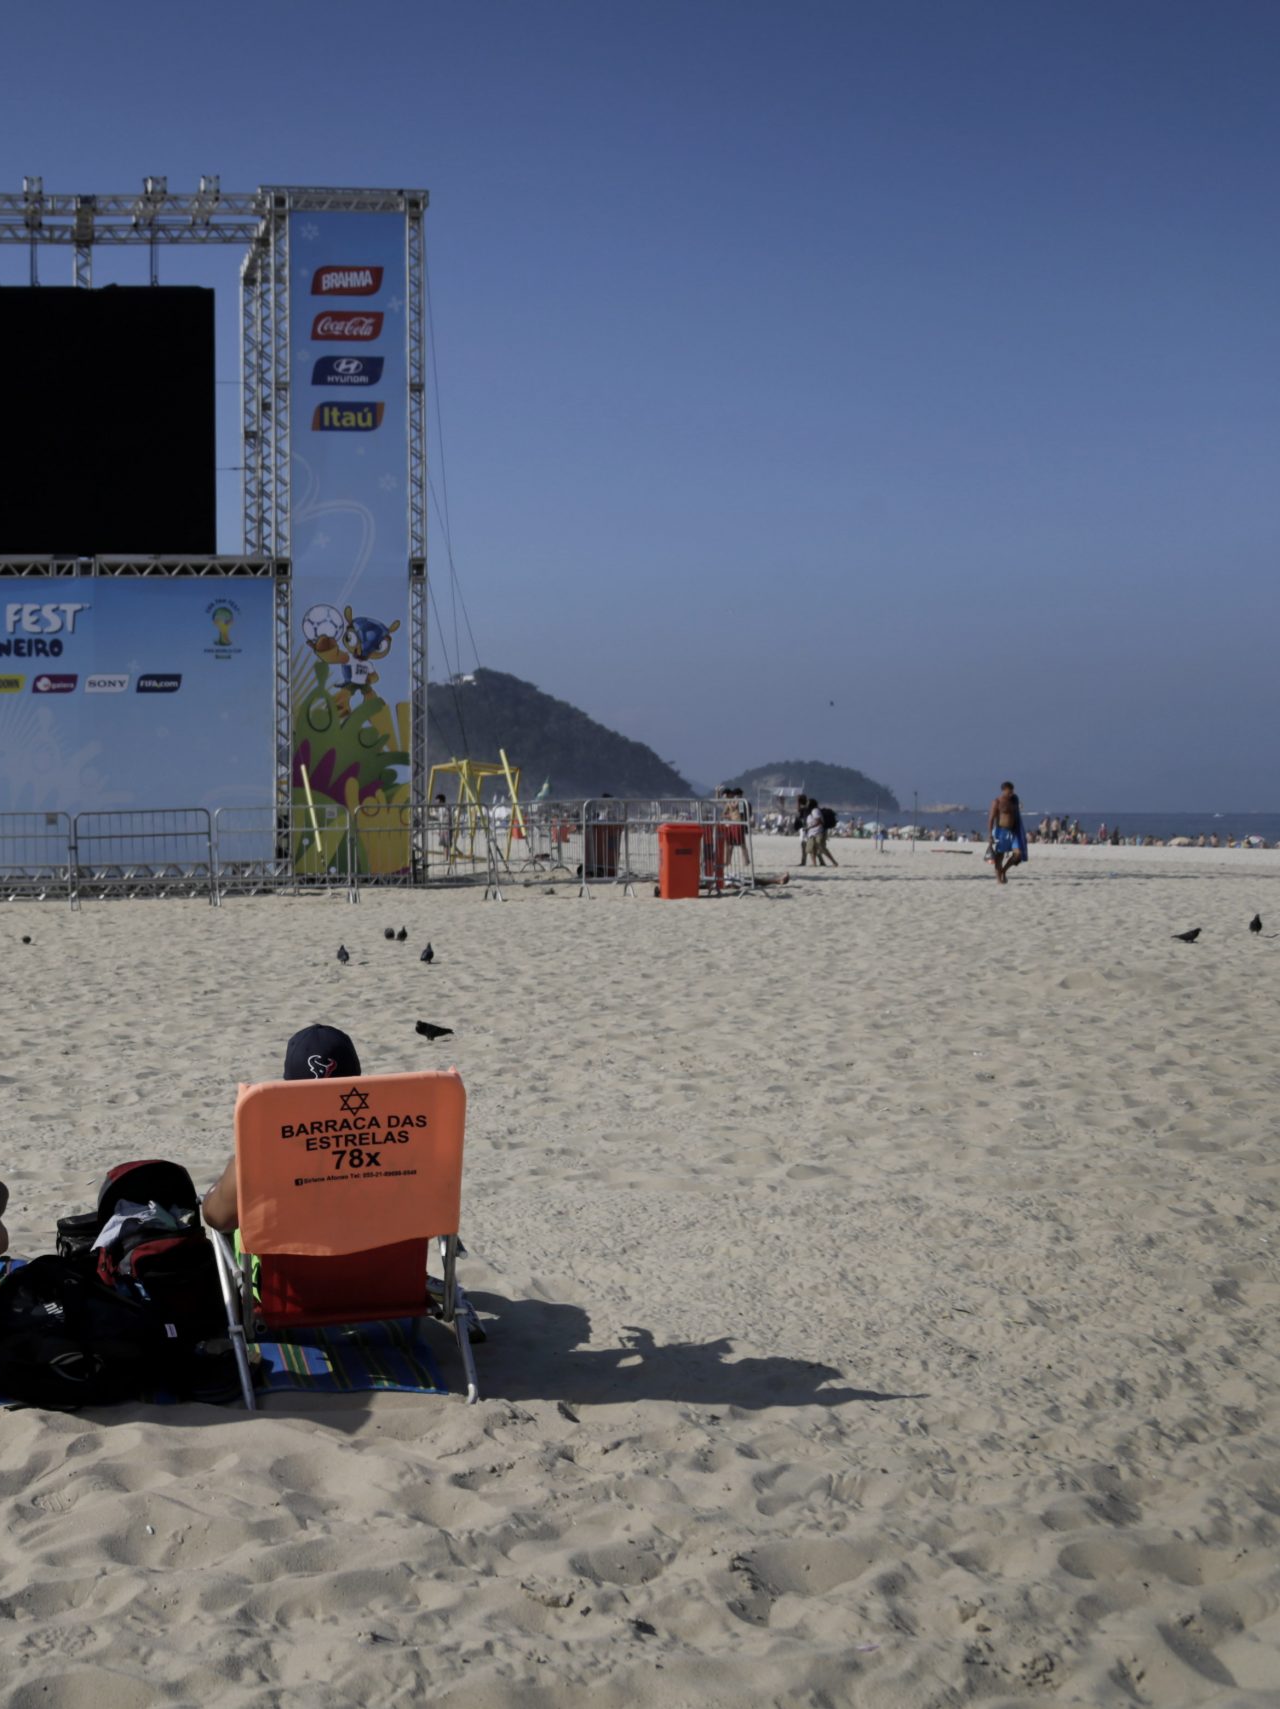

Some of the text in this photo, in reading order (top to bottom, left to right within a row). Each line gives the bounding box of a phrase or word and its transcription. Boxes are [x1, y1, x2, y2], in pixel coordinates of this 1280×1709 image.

[321, 269, 373, 292] BRAHMA
[326, 375, 369, 384] HYUNDAI
[323, 406, 373, 428] Itaú
[5, 603, 85, 635] FEST
[87, 679, 126, 688] SONY
[139, 679, 179, 689] FIFA.com
[281, 1114, 427, 1139] BARRACA DAS
[305, 1130, 410, 1151] ESTRELAS
